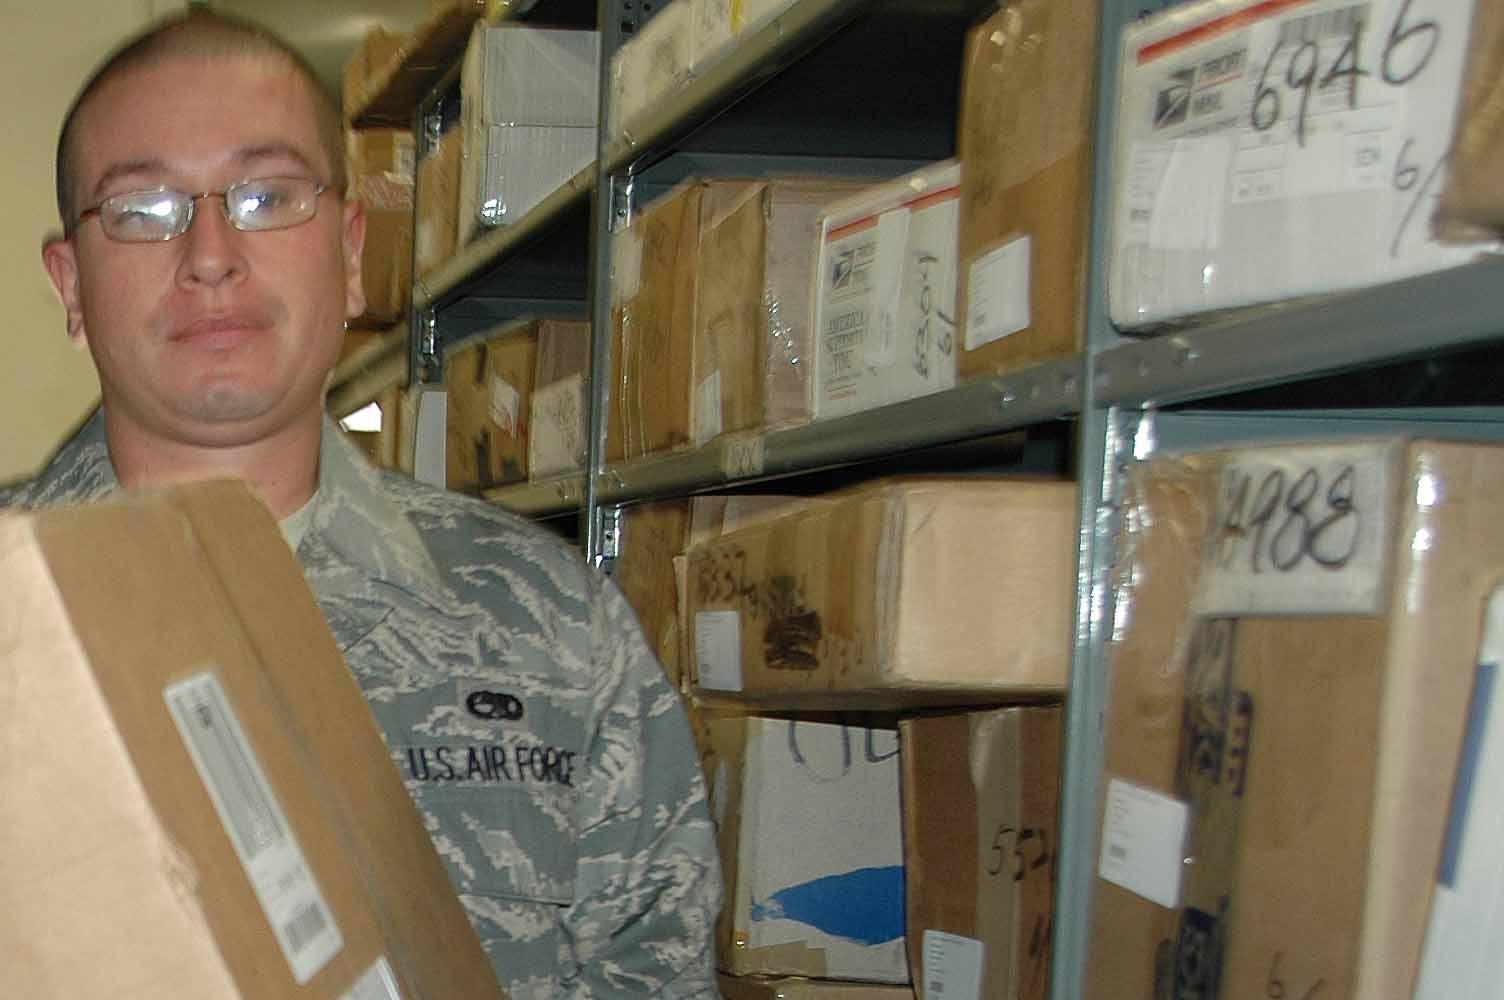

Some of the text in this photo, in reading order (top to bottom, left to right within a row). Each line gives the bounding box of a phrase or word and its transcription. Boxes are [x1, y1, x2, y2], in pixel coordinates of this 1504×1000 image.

[1250, 0, 1441, 148] 6946
[407, 747, 462, 782] U.S.
[467, 747, 512, 782] AIR
